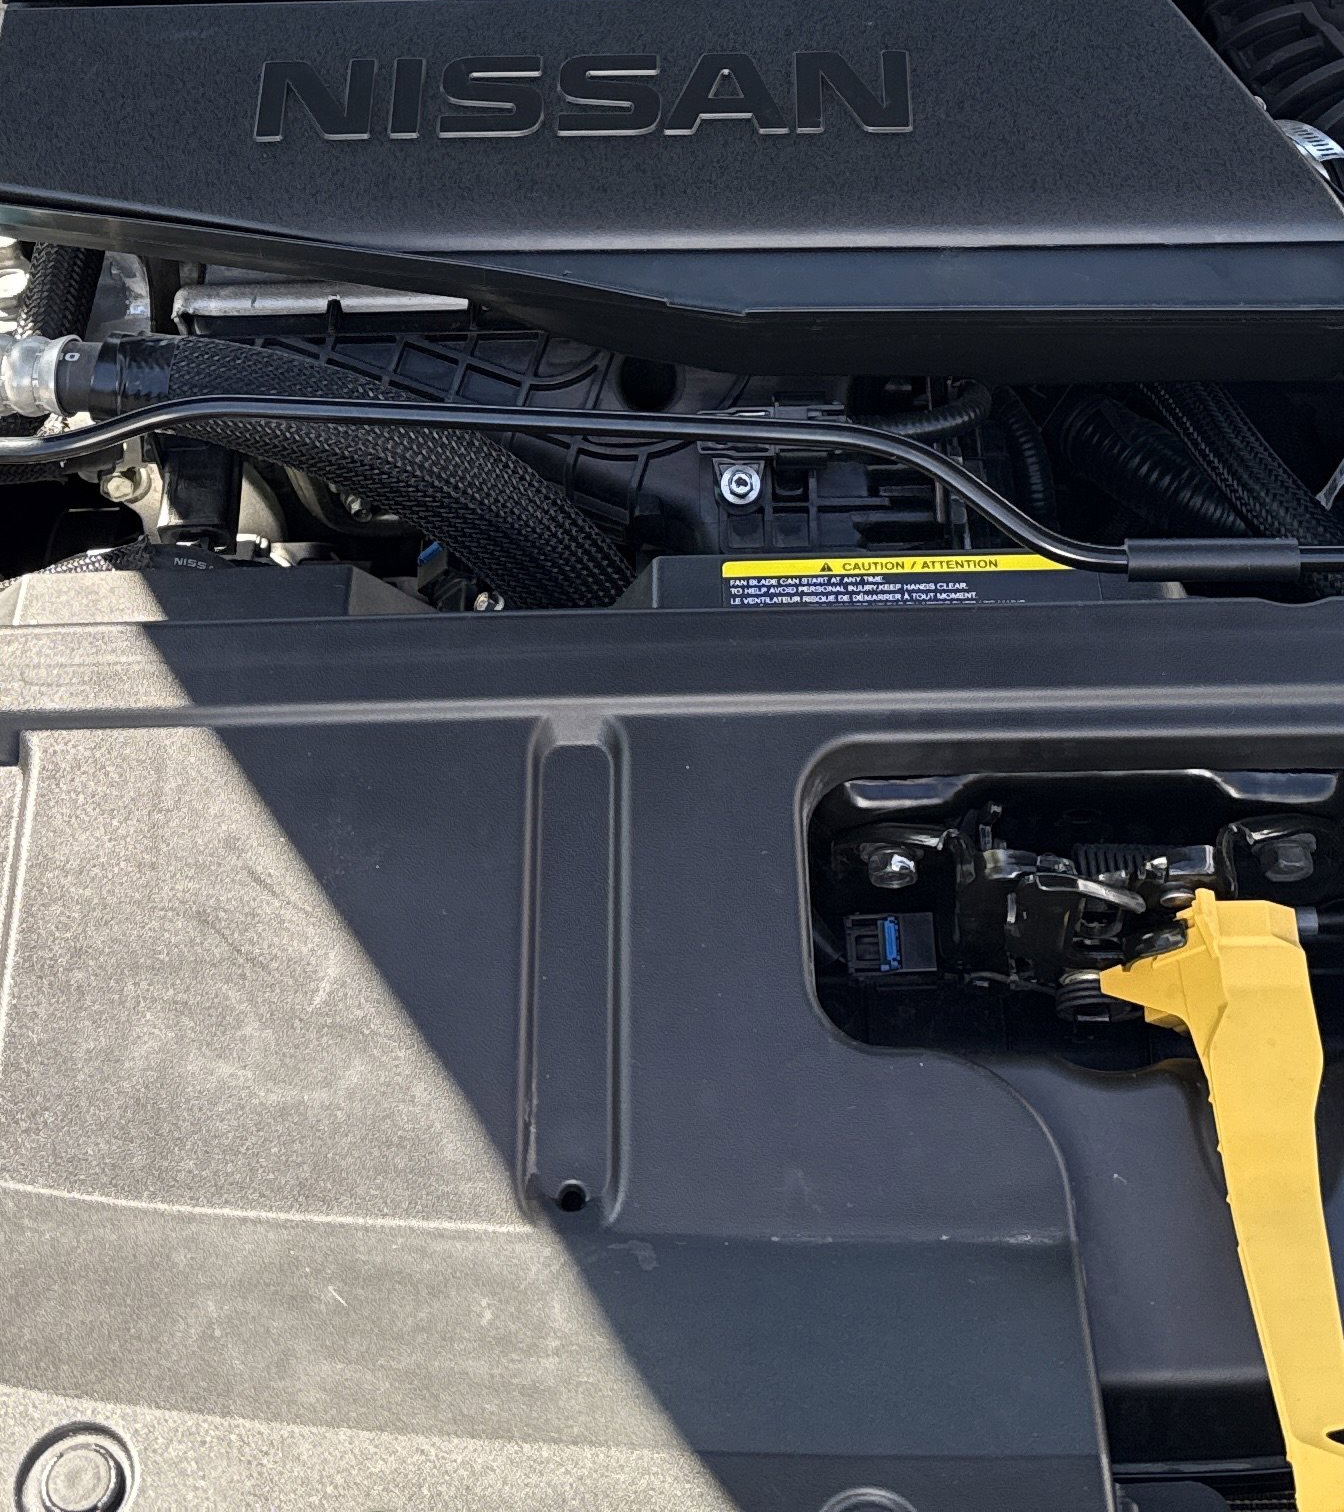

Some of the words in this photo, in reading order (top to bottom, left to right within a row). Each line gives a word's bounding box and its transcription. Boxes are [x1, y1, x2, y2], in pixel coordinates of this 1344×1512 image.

[254, 49, 914, 141] NISSAN
[174, 557, 214, 570] NISS
[842, 561, 905, 572] CAUTION
[921, 559, 998, 570] ATTENTION
[730, 579, 747, 587] FAN
[749, 578, 778, 586] BLADE
[744, 587, 767, 595] HELP
[798, 586, 846, 594] PERSONAL
[937, 582, 968, 590] CLEAR.
[730, 597, 741, 605] LE
[743, 596, 800, 604] VENTILATEUR
[802, 595, 836, 603] RISQUE
[911, 592, 935, 600] TOUT
[937, 591, 978, 599] MOMENT.
